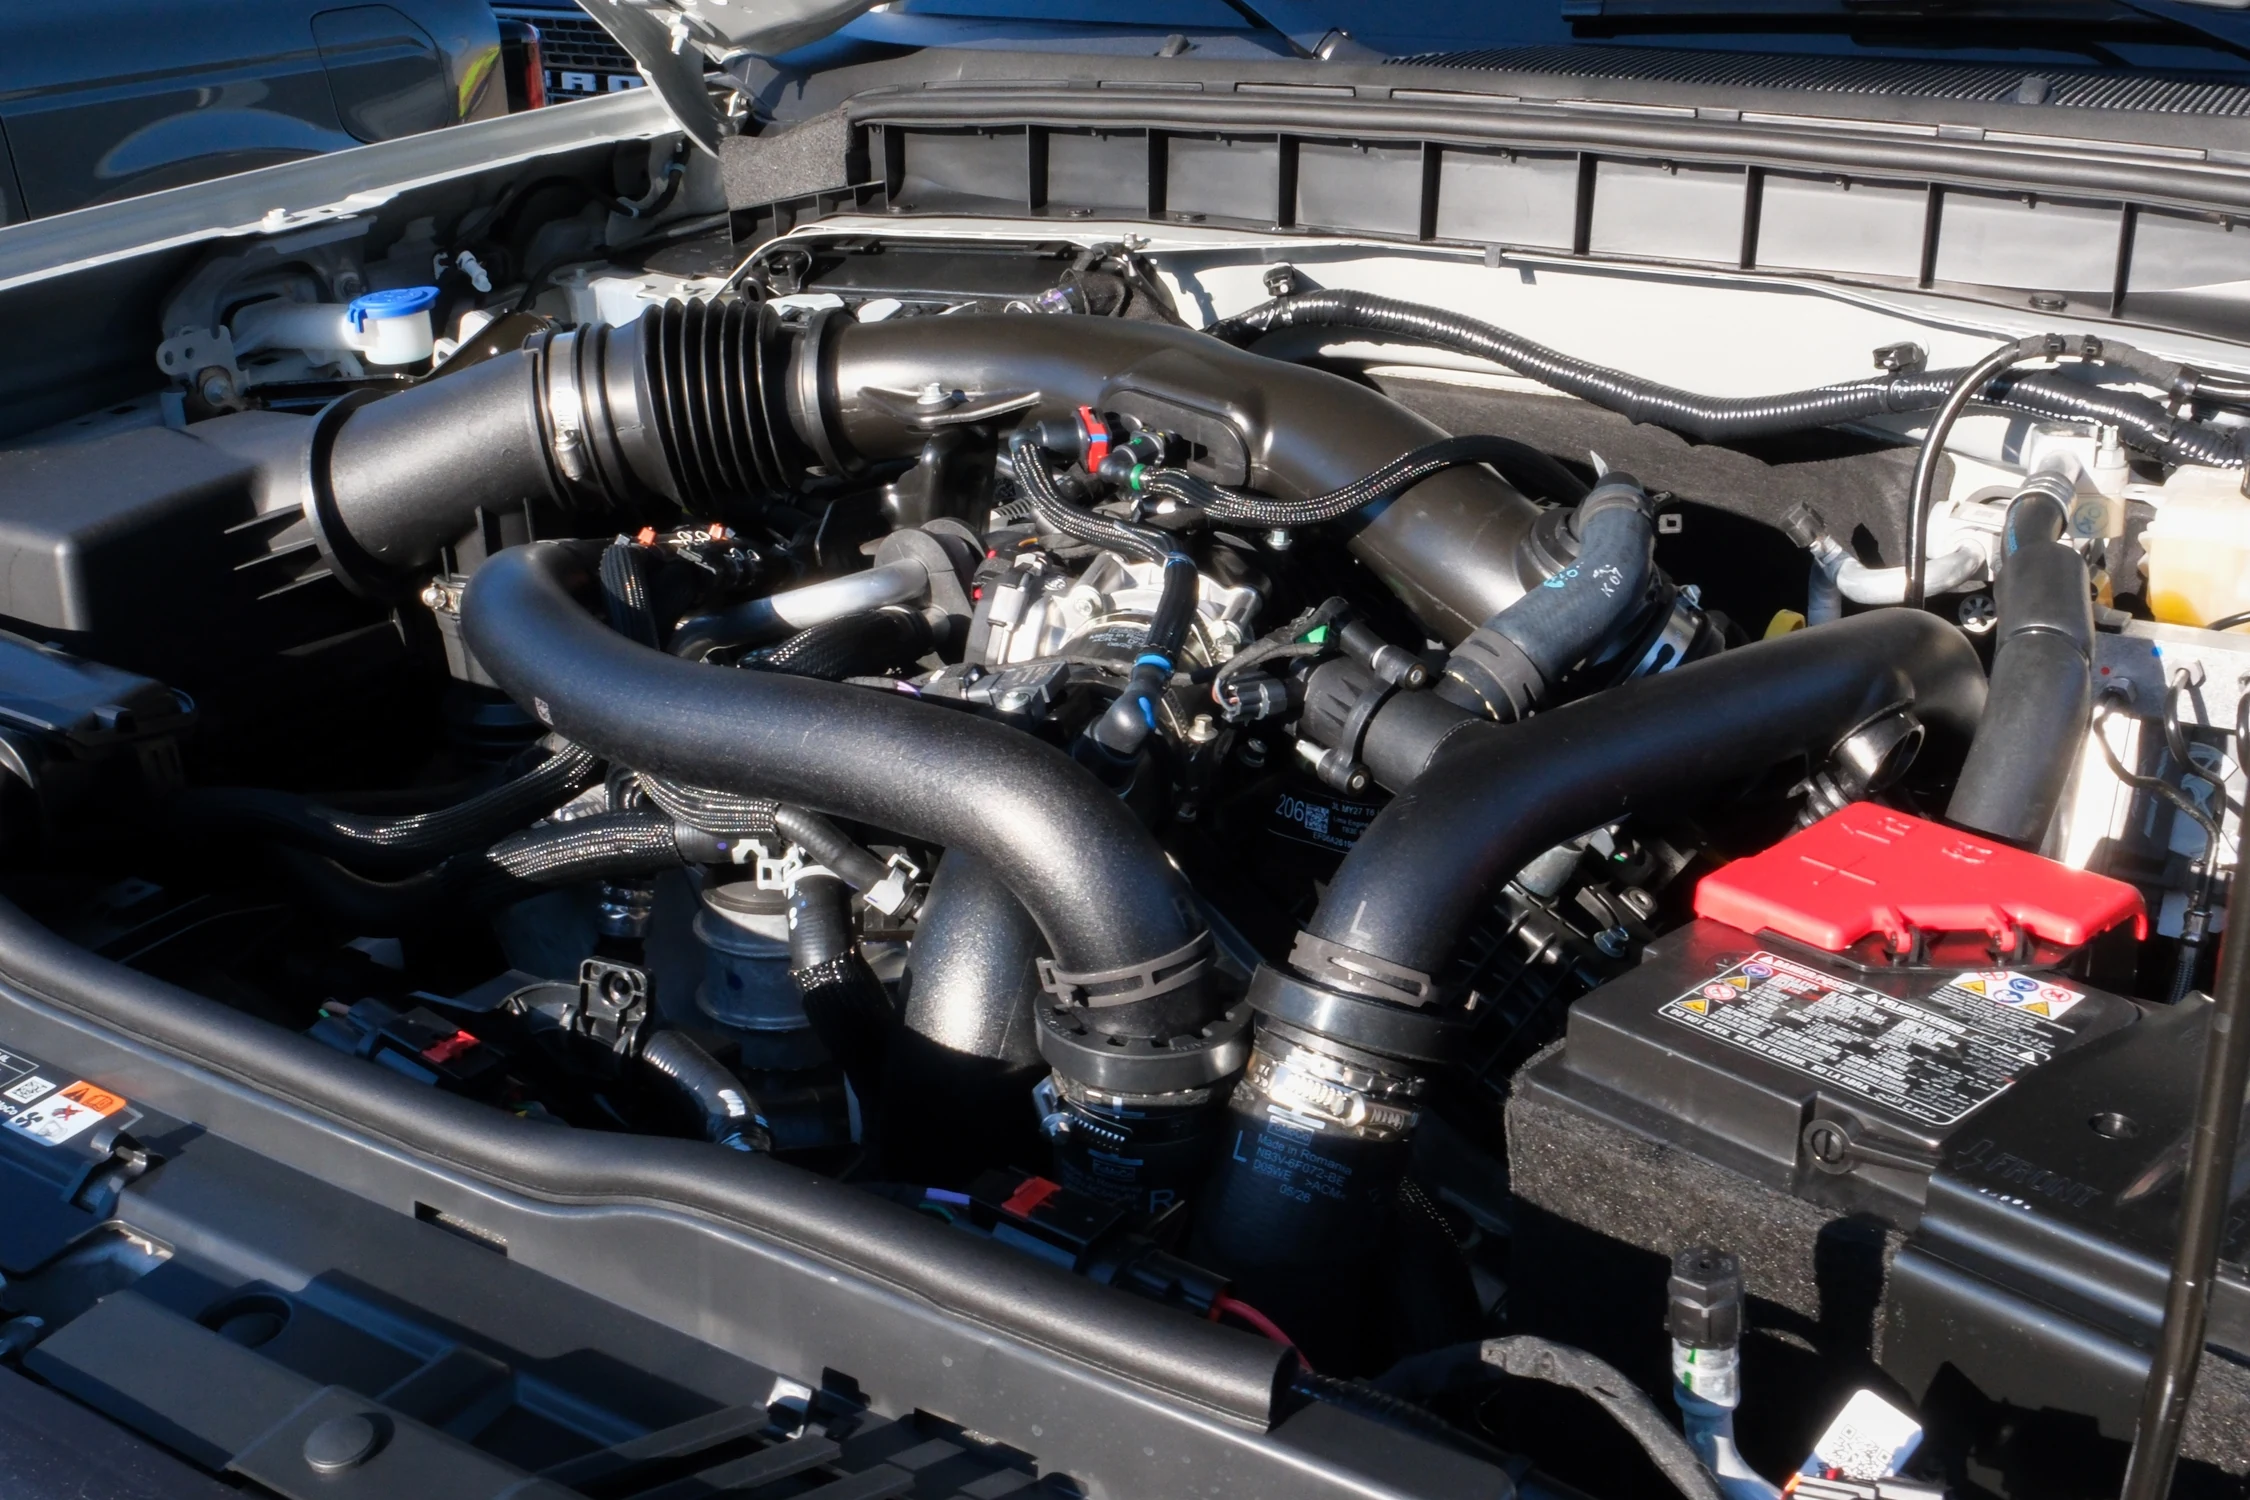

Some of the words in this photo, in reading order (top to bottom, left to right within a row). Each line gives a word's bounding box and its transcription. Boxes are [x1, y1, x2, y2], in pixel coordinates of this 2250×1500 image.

[1275, 793, 1305, 822] 206
[1770, 959, 1859, 993] DANGER/POISON
[1874, 997, 1970, 1034] PELIGRO/VENENO
[1667, 1009, 1686, 1017] DO
[1682, 1014, 1705, 1025] NOT
[1701, 1022, 1734, 1036] OPEN.
[1732, 1034, 1750, 1042] NE
[1746, 1040, 1770, 1050] PAS
[1765, 1047, 1810, 1066] OUVRIR.
[1809, 1064, 1828, 1073] NO
[1824, 1070, 1843, 1079] LA
[1838, 1076, 1875, 1092] ABRA.
[1232, 1130, 1248, 1163] L
[1257, 1133, 1285, 1151] Made
[1287, 1143, 1298, 1157] in
[1300, 1149, 1353, 1176] Romania
[1984, 1152, 2104, 1208] FRONT
[1149, 1189, 1175, 1214] R
